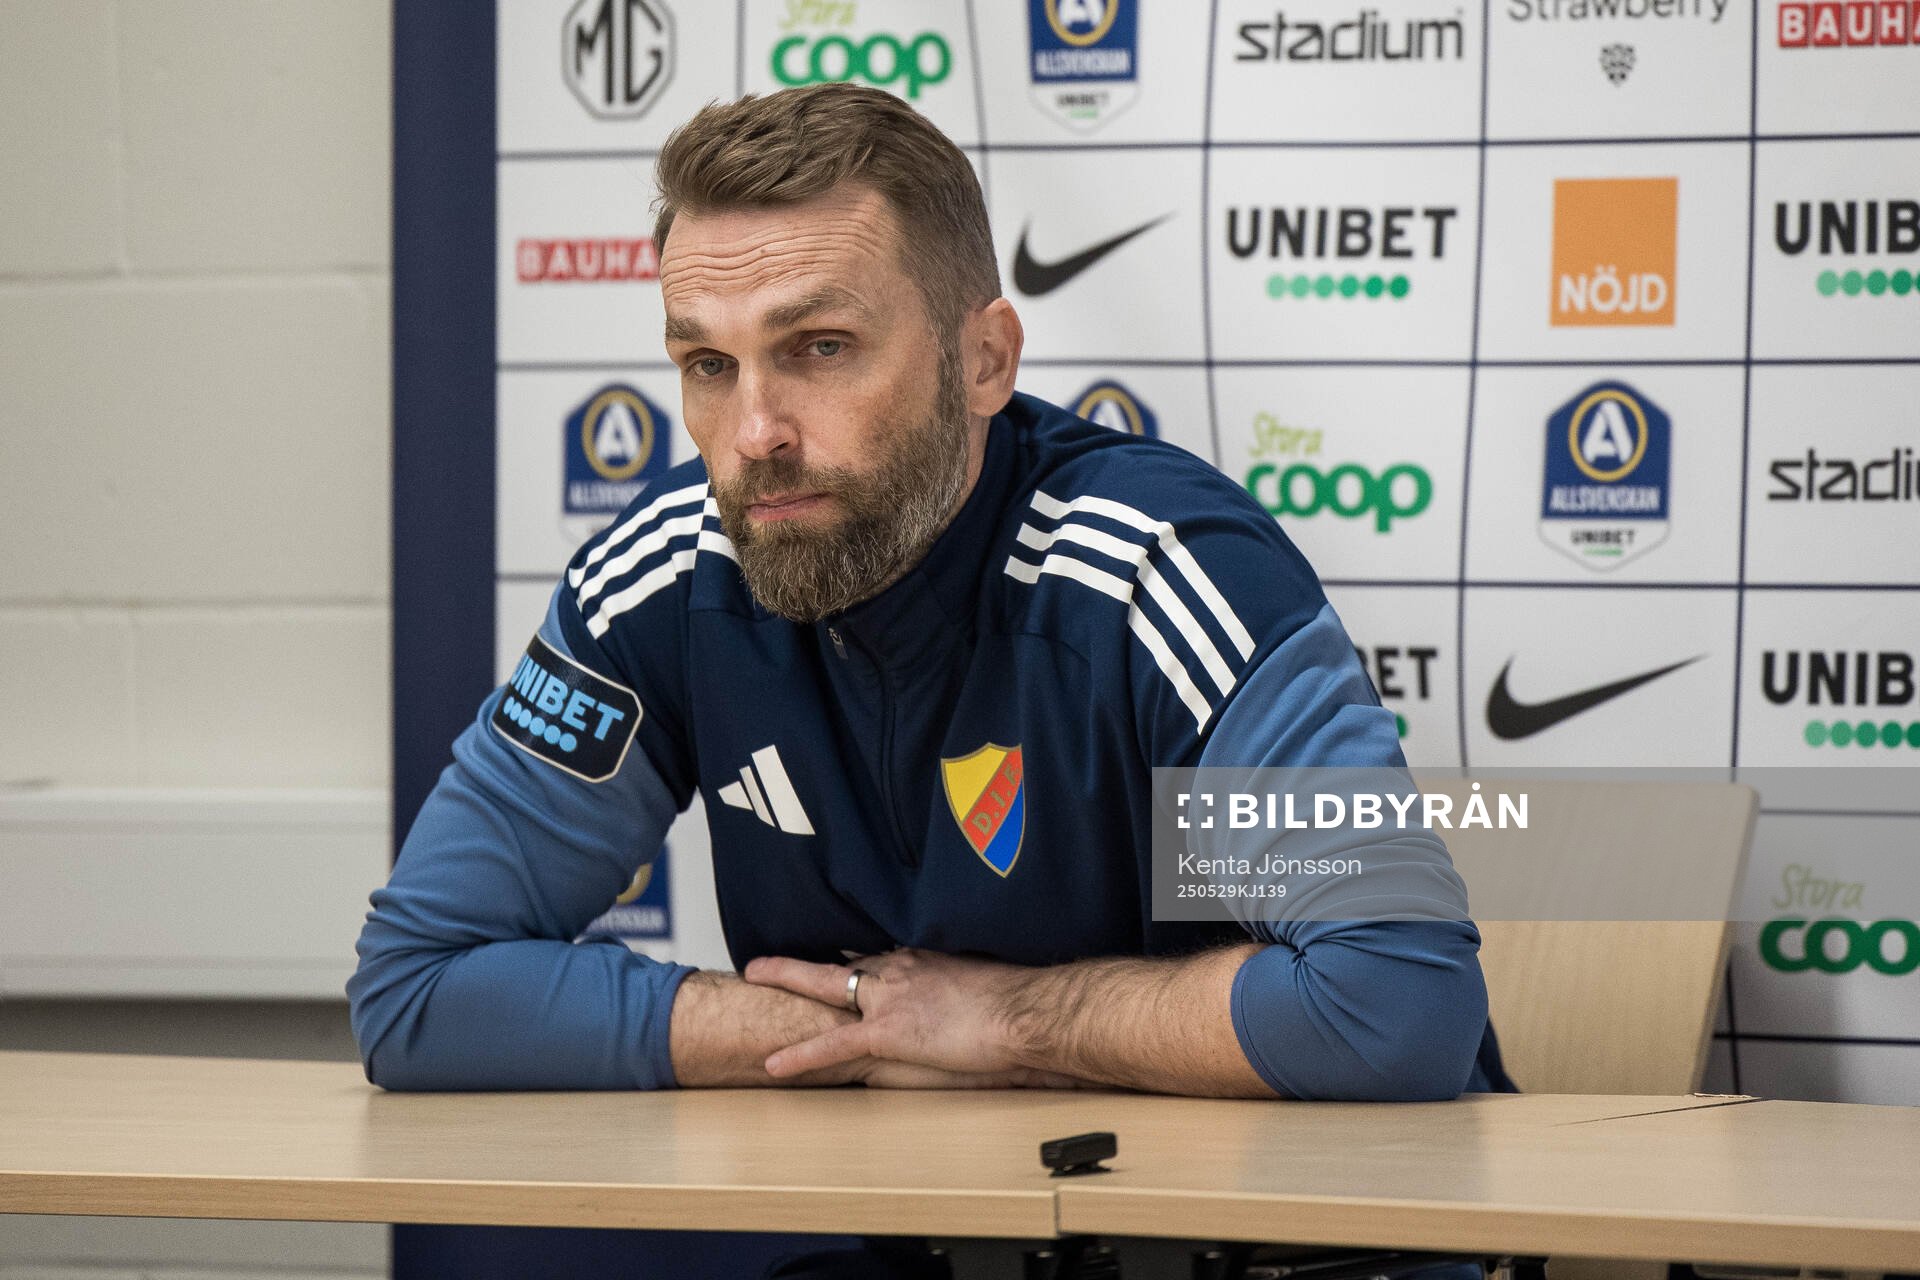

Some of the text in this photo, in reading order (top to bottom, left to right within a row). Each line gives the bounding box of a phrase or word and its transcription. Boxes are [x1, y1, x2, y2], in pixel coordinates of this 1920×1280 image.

[1235, 9, 1464, 61] stadium
[1780, 4, 1920, 43] BAUH
[575, 0, 663, 105] MG
[771, 33, 952, 99] coop
[1227, 207, 1458, 259] UNIBET
[1775, 200, 1920, 256] UNIB
[1559, 264, 1668, 313] NÖJD
[1582, 400, 1634, 464] A
[1246, 462, 1432, 534] coop
[1768, 447, 1920, 501] stadi
